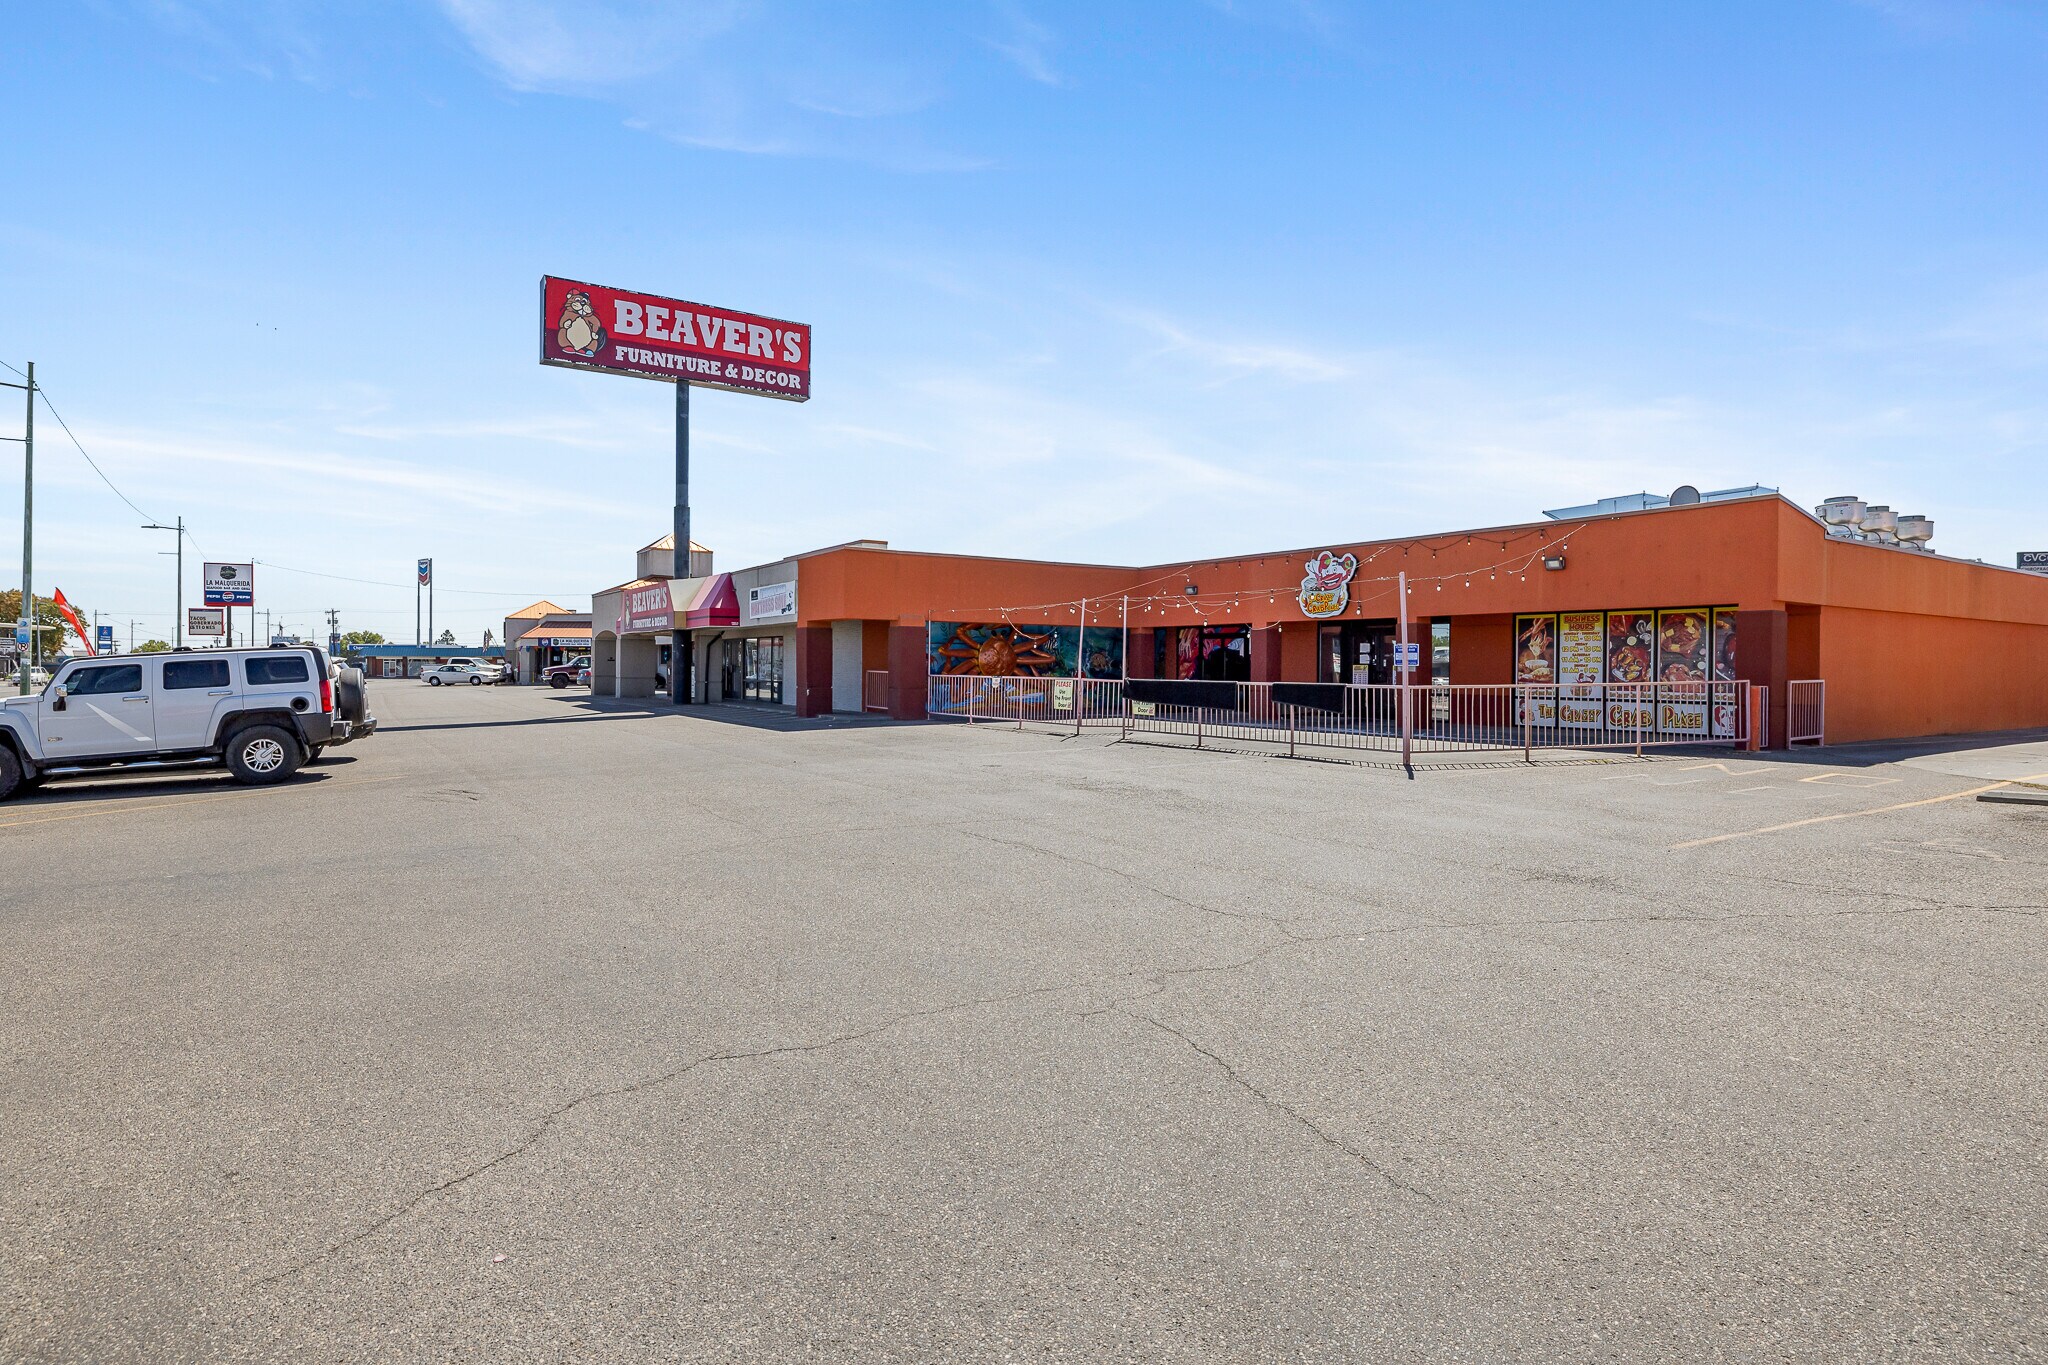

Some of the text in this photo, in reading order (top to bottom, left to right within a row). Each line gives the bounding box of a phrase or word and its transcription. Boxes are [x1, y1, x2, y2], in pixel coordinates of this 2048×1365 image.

[613, 299, 801, 364] BEAVER'S
[615, 345, 801, 389] FURNITURE & DECOR
[2023, 553, 2048, 562] CVC
[632, 587, 667, 613] BEAVER'S
[1564, 615, 1600, 623] BUSINESS
[1569, 623, 1595, 631] HOURS
[1560, 704, 1602, 723] CRAZY
[1609, 704, 1653, 728] CRAB
[1662, 704, 1704, 729] PLACE
